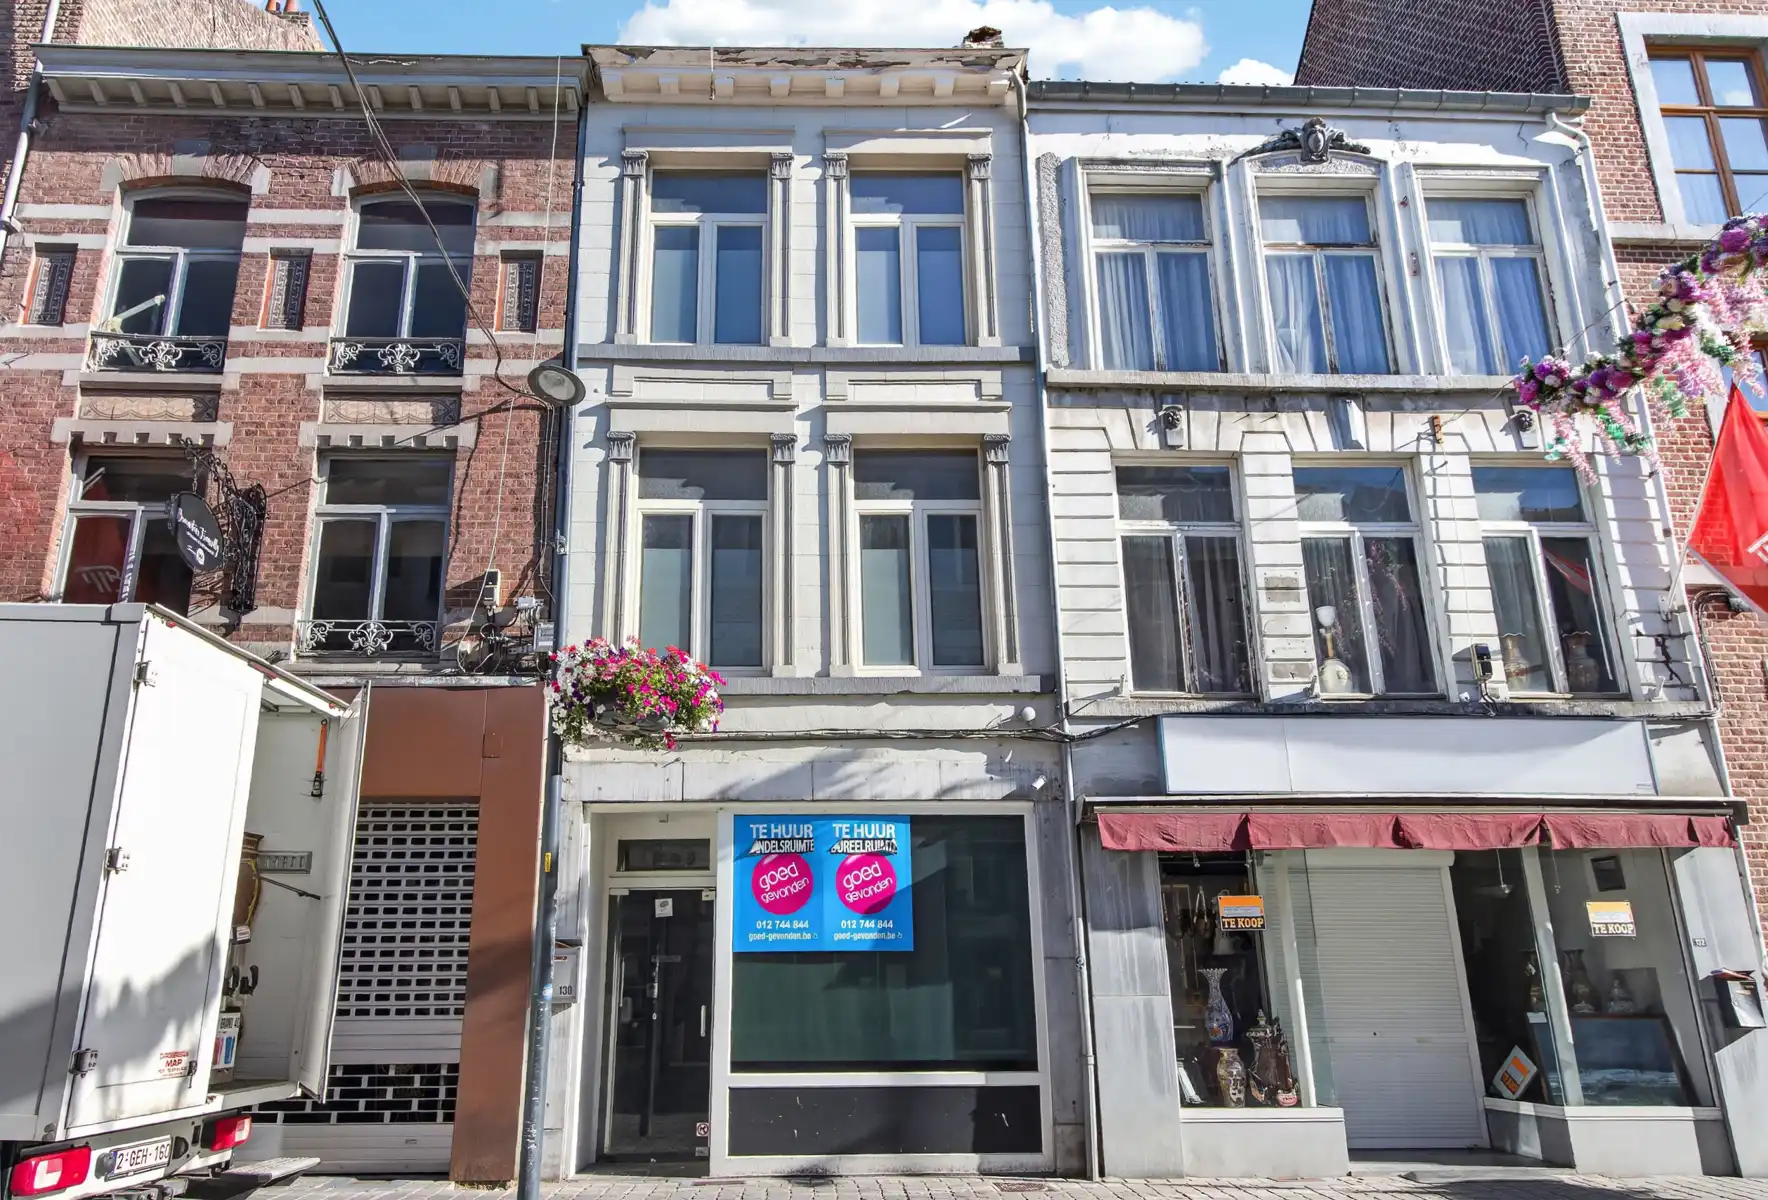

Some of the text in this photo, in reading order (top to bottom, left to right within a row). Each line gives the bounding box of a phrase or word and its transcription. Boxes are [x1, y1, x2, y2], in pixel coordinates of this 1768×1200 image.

[750, 824, 813, 838] TE HUUR
[832, 823, 896, 838] TE HUUR
[760, 861, 799, 891] goed
[843, 861, 882, 891] goed
[760, 877, 809, 903] gevonden
[845, 877, 893, 903] gevonden
[756, 920, 809, 929] 012 744 844
[841, 920, 893, 929] 012 744 844
[1222, 917, 1264, 928] TE KOOP
[1592, 923, 1634, 934] TE KOOP
[559, 985, 573, 995] 130
